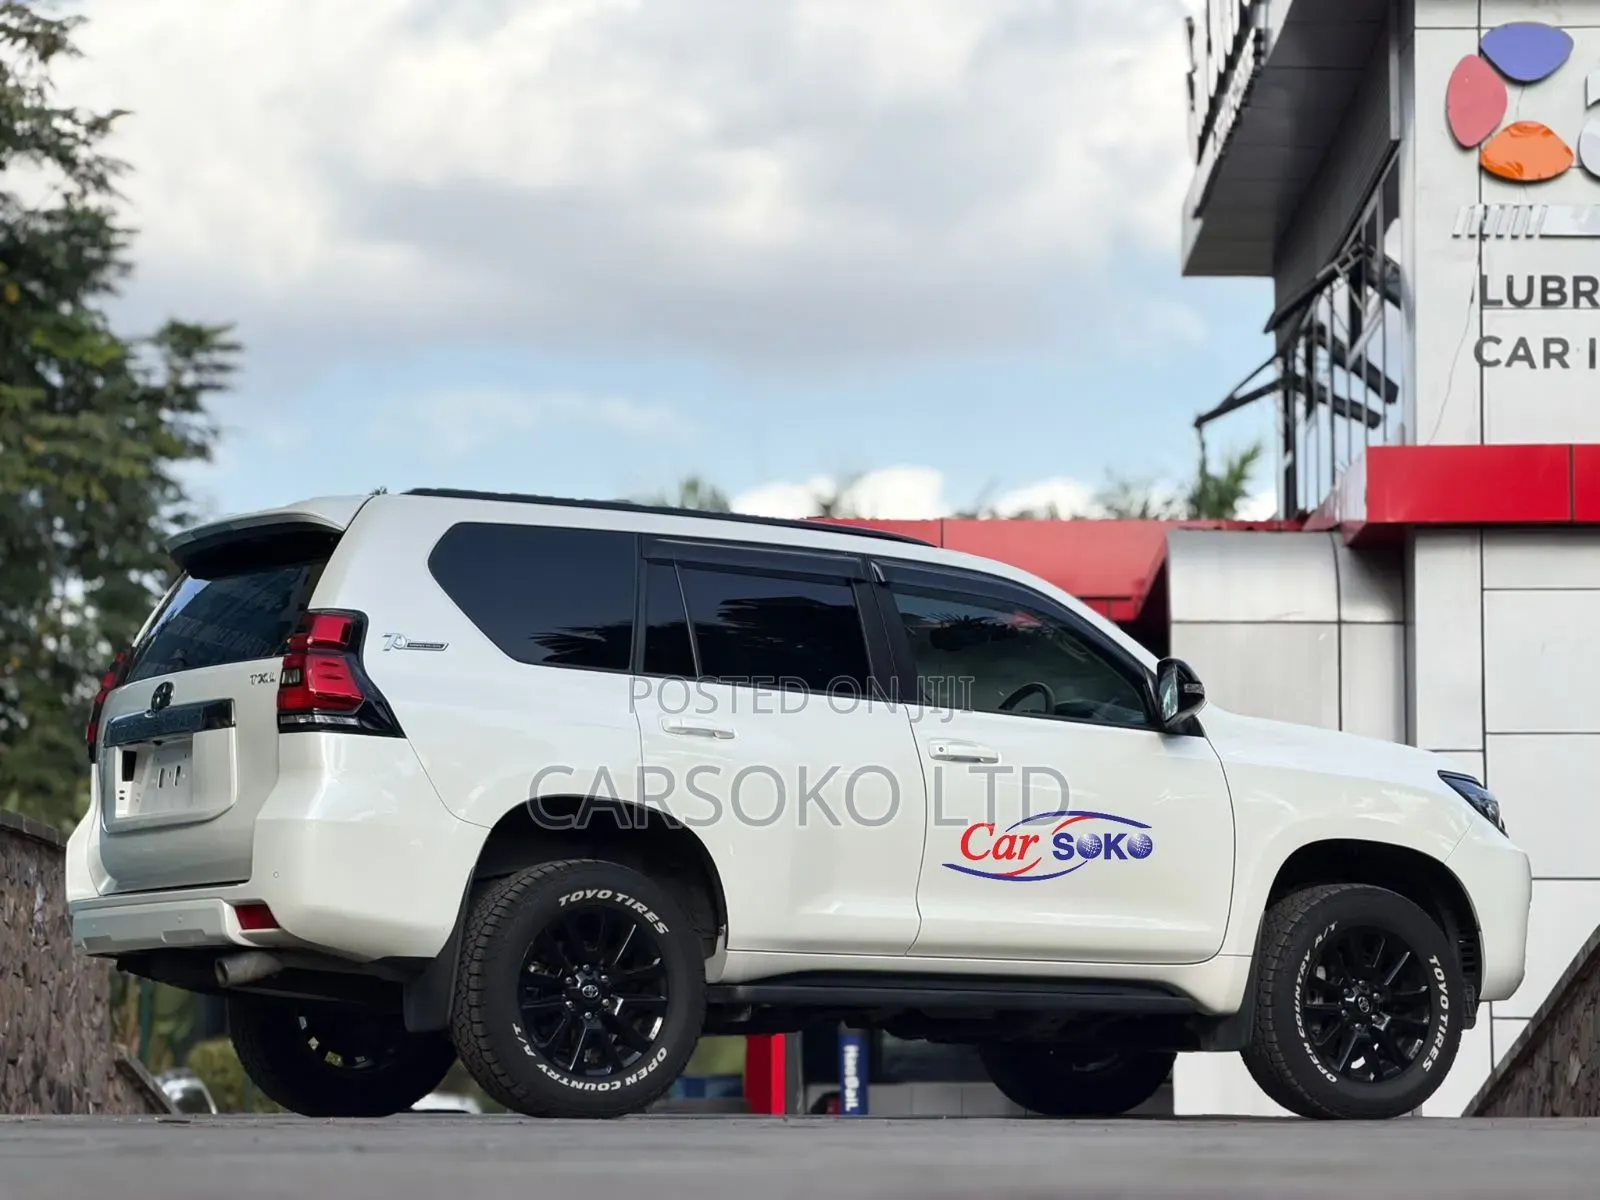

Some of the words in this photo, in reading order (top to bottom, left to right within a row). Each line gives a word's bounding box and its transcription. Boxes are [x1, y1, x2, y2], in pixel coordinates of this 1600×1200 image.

[1481, 274, 1600, 308] LUBR
[1473, 335, 1570, 369] CAR
[558, 888, 610, 907] TOYO
[615, 892, 669, 935] TIRES
[1293, 949, 1311, 1038] COUNTRY
[1428, 955, 1449, 1009] TOYO
[512, 1022, 537, 1057] A/T
[1422, 1013, 1449, 1072] TIRES
[536, 1063, 622, 1092] COUNTRY
[625, 1047, 668, 1086] OPEN
[1303, 1042, 1337, 1083] OPEN
